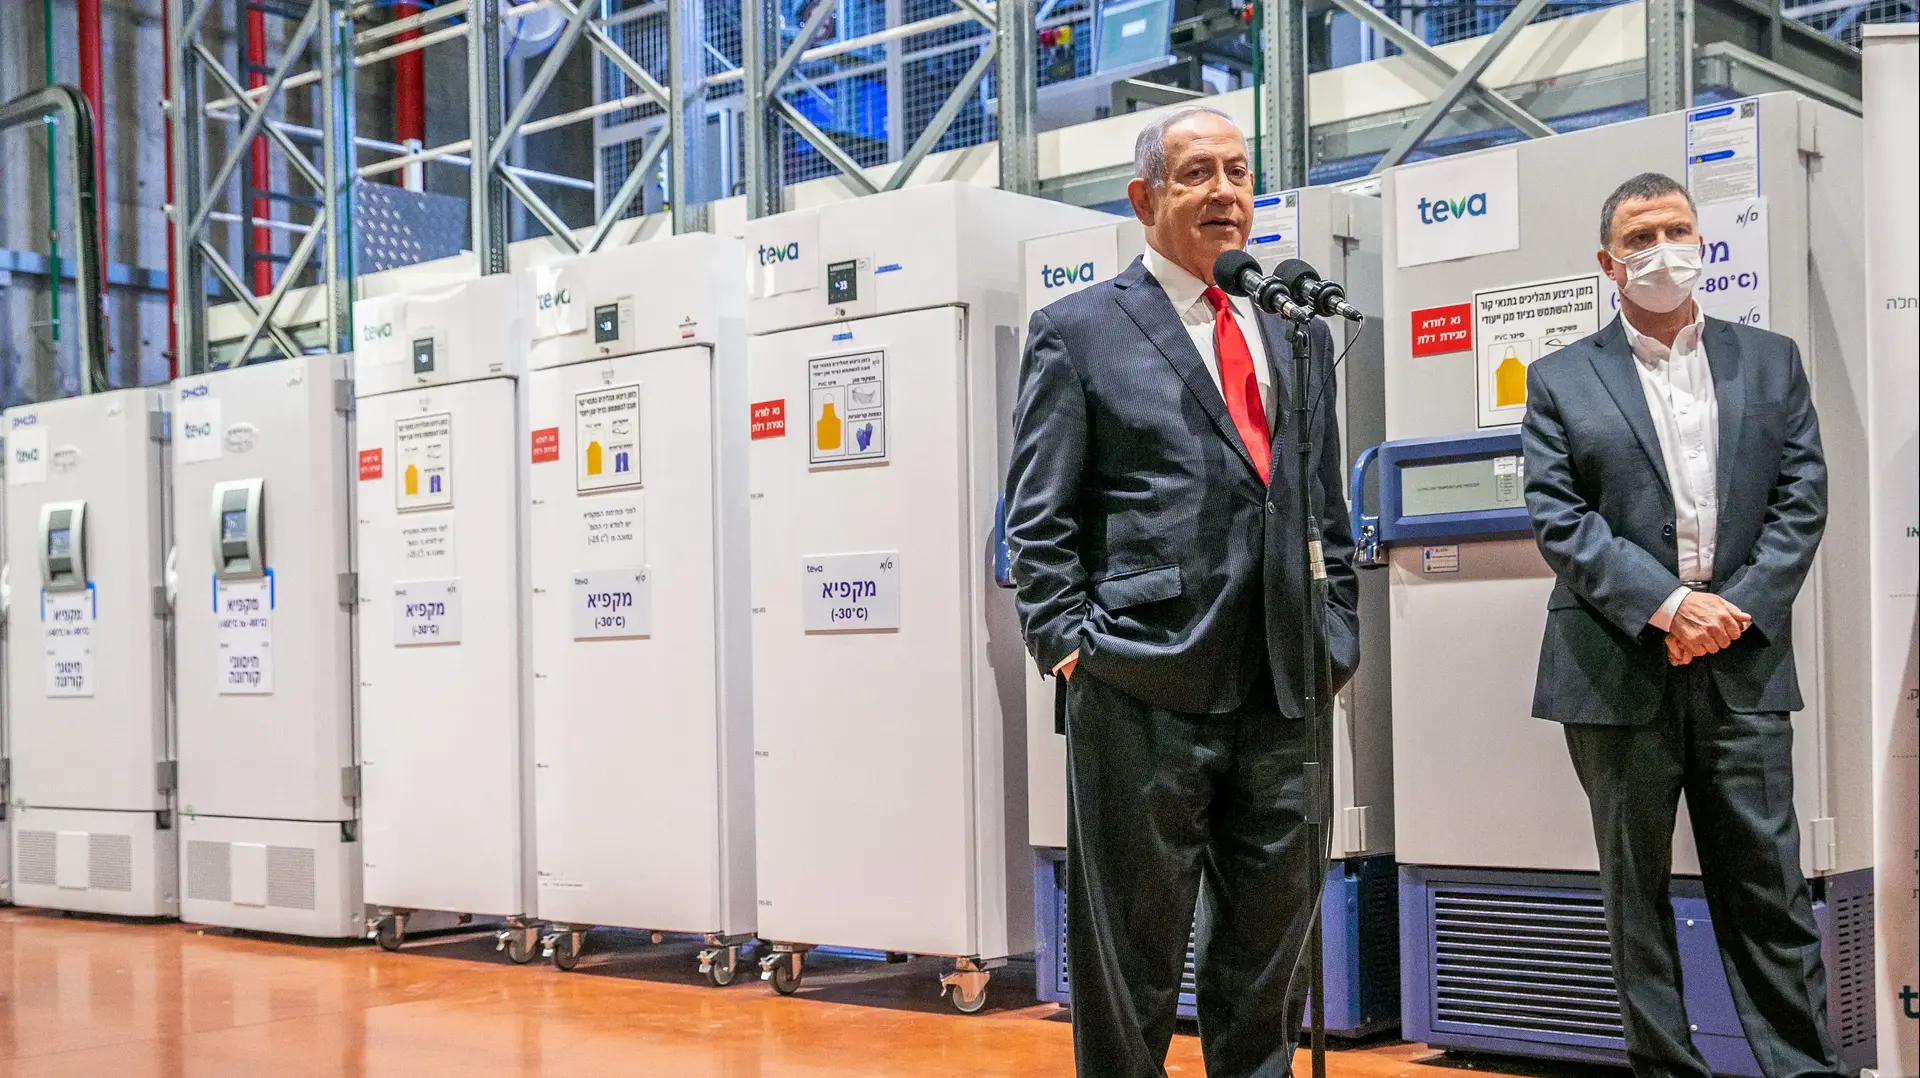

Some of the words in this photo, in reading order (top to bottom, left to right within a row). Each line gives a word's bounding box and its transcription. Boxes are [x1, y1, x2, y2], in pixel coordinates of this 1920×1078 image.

[1418, 192, 1486, 224] teva
[758, 242, 799, 266] teva
[1041, 261, 1094, 289] teva
[1519, 291, 1551, 305] תהליכים
[1553, 288, 1574, 300] ביצוע
[1576, 286, 1593, 299] בזמן
[537, 288, 571, 310] teva
[1481, 299, 1493, 311] קור
[1495, 297, 1517, 307] בתנאי
[1537, 303, 1572, 318] להשתמש
[1574, 302, 1593, 312] חובה
[1450, 316, 1461, 325] נא
[1502, 312, 1514, 324] מגן
[1516, 310, 1535, 320] בציוד
[1422, 316, 1446, 329] לוודא
[1416, 334, 1436, 345] דלת
[1439, 330, 1467, 342] סגירת
[1494, 333, 1508, 341] PVC
[772, 406, 781, 415] נא
[752, 423, 765, 433] דלת
[766, 420, 784, 430] סגירת
[806, 564, 823, 573] teva
[822, 580, 877, 603] מקפיא
[587, 592, 632, 612] מקפיא
[405, 602, 445, 621] מקפיא
[831, 607, 869, 622] (-30°C)
[594, 616, 626, 630] (-30°C)
